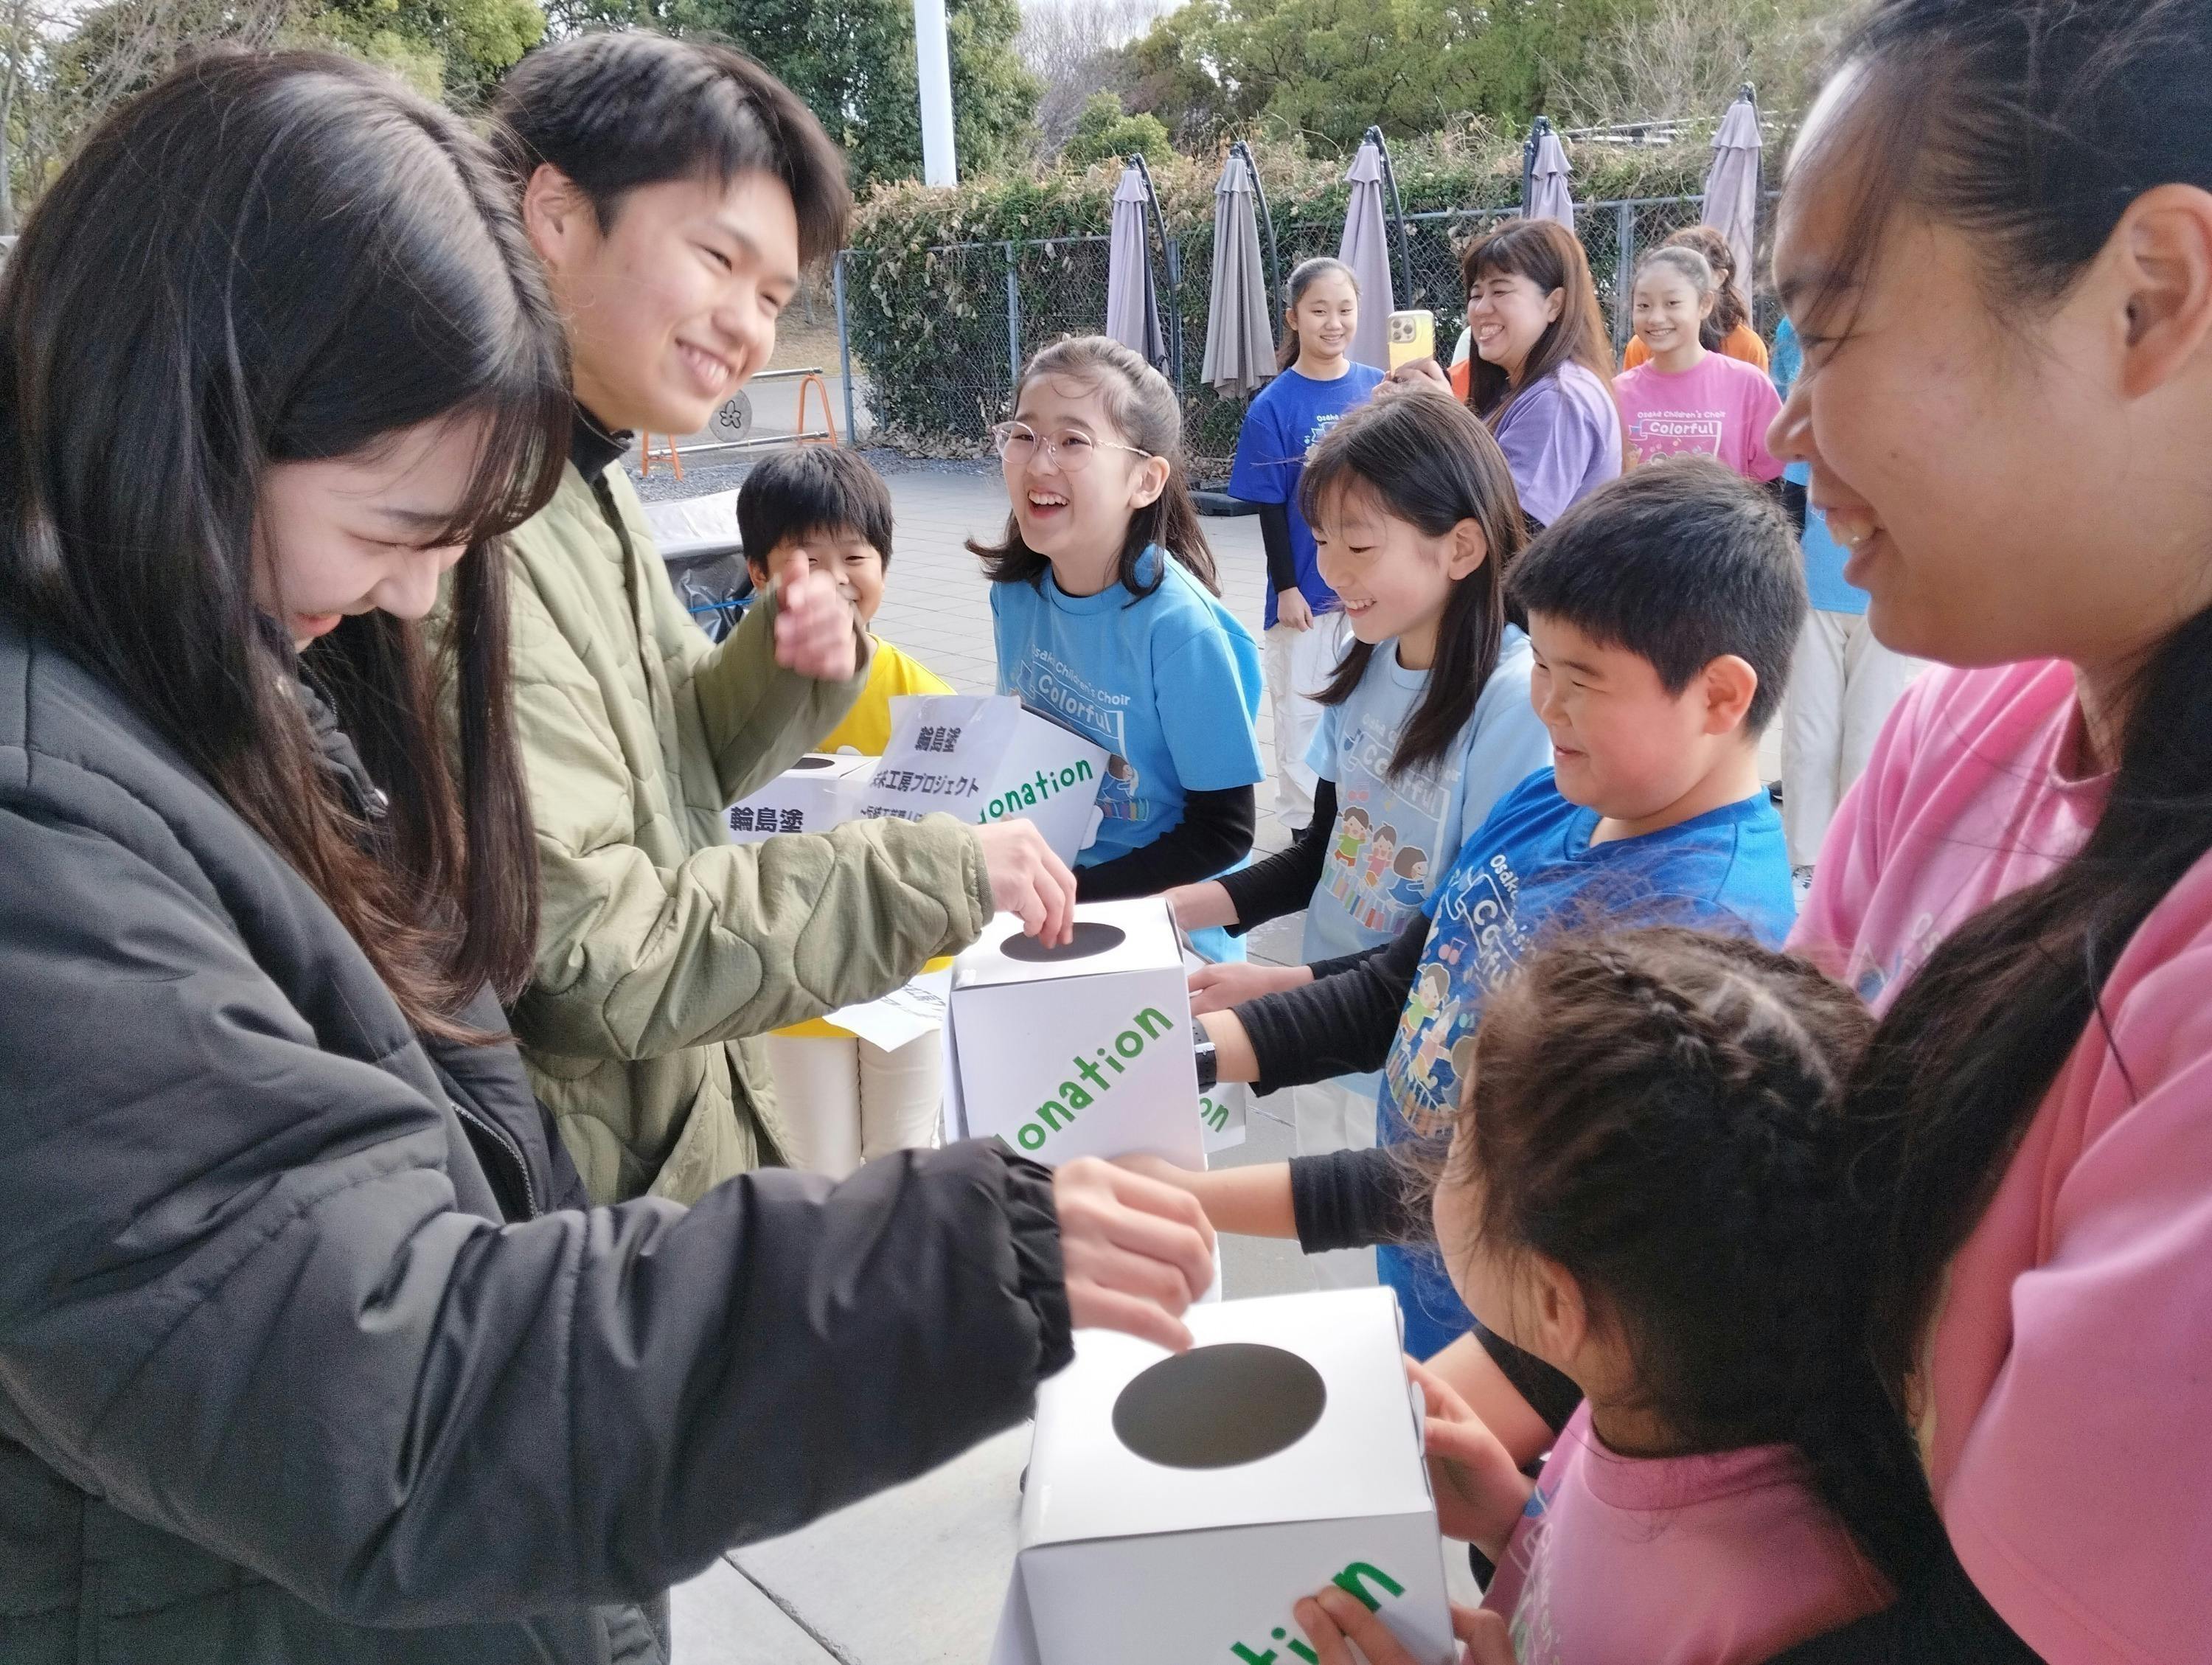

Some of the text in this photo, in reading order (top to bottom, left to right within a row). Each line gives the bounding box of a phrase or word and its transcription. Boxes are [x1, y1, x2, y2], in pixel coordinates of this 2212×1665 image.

[1649, 422, 1714, 435] Colorful
[1038, 674, 1112, 734] Colorful
[1097, 690, 1131, 706] Choir
[914, 726, 961, 753] 輪島塗
[730, 806, 804, 833] 輪島塗
[993, 1007, 1174, 1156] onation
